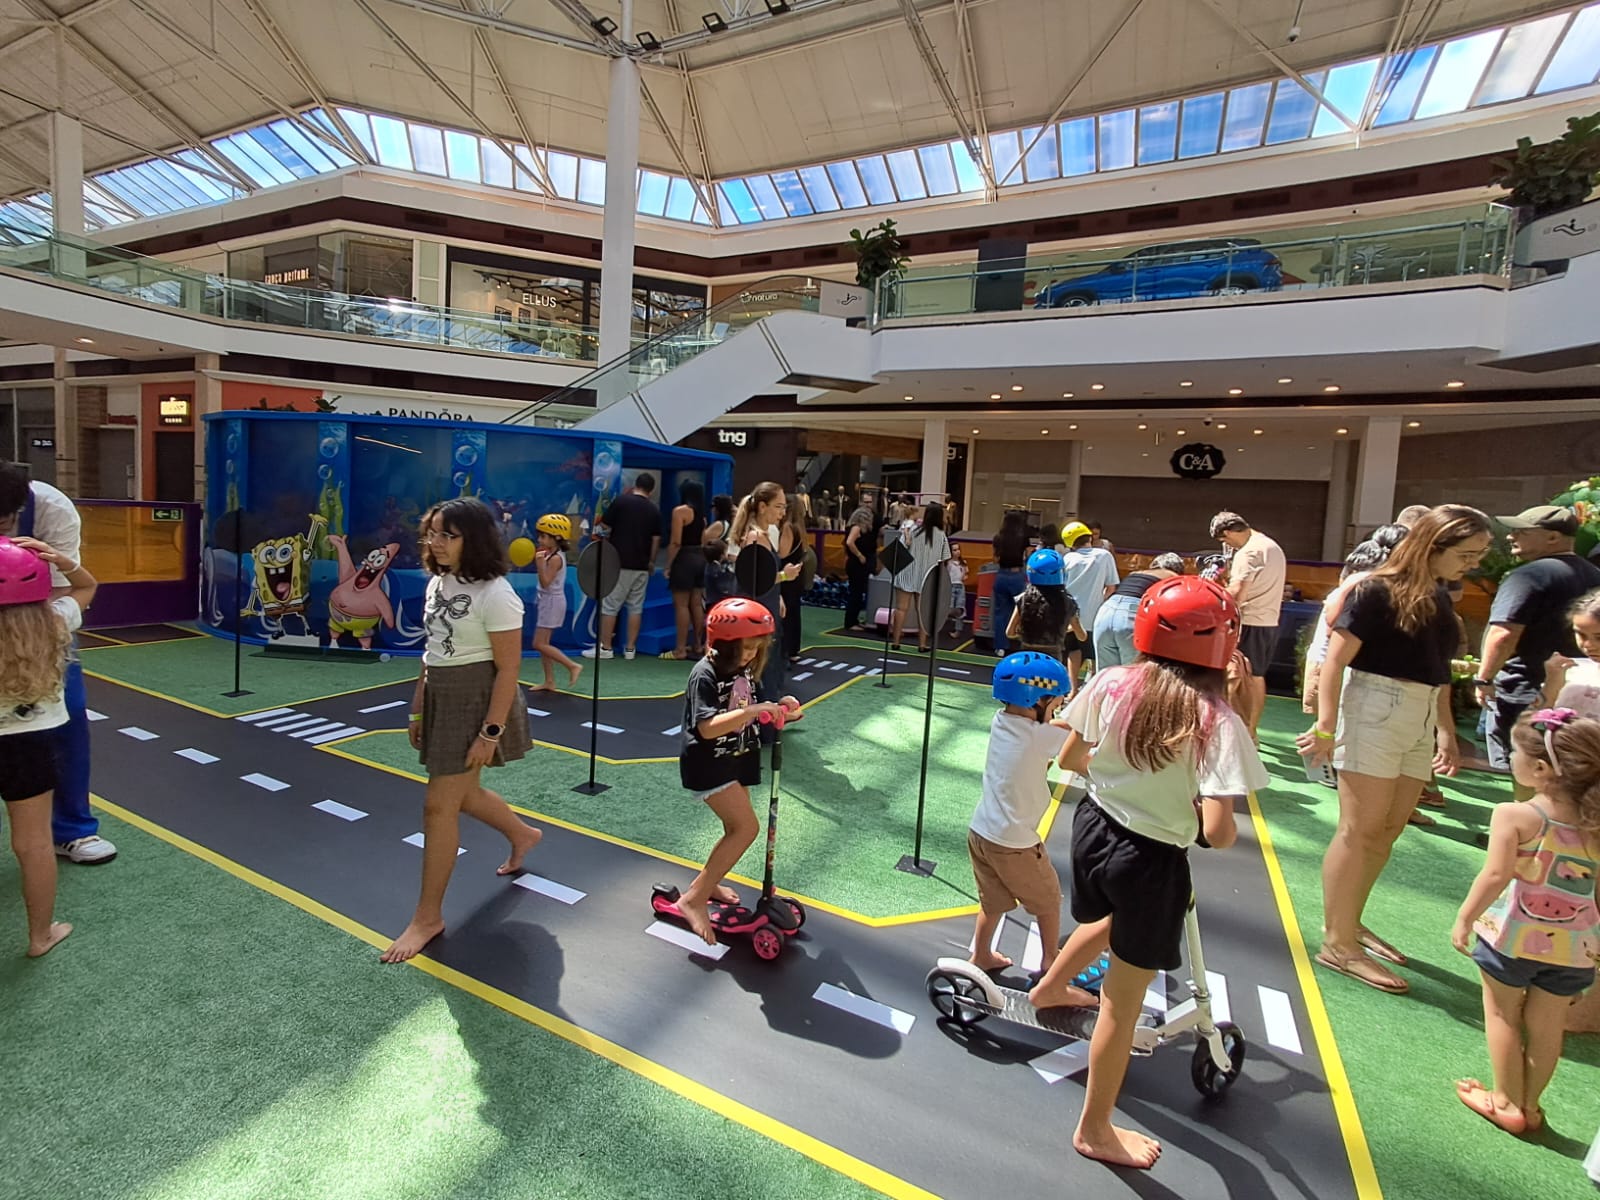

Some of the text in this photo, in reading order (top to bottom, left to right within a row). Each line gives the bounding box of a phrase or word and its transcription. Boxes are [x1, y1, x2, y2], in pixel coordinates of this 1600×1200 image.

[522, 293, 557, 308] ELLUS
[718, 429, 747, 446] tng
[1179, 453, 1216, 471] C&A
